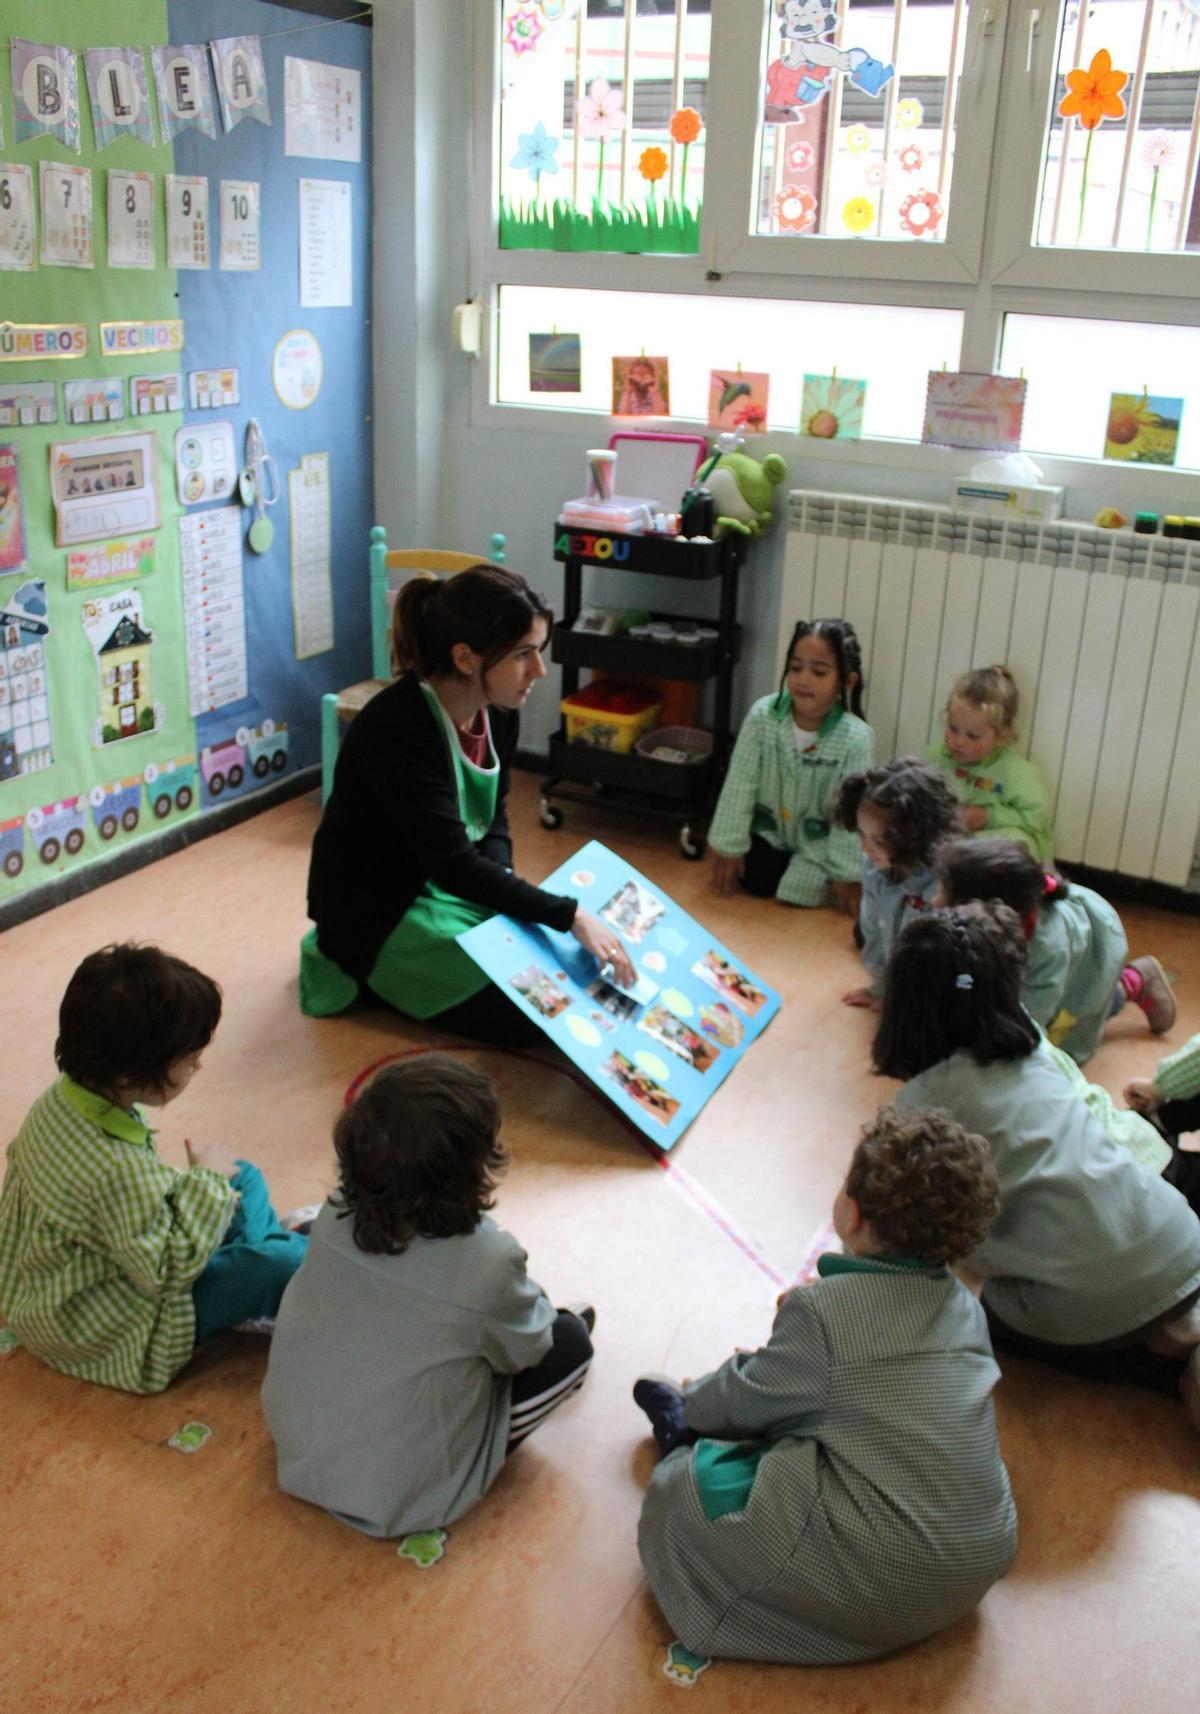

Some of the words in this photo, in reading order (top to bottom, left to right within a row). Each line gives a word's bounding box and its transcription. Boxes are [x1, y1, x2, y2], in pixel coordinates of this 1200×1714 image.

[0, 179, 12, 210] 6
[62, 179, 73, 208] 7
[126, 184, 136, 214] 8
[182, 189, 192, 217] 9
[231, 194, 249, 221] 10
[104, 327, 180, 348] VECINOS
[554, 533, 631, 561] AEIOU
[87, 549, 137, 579] ABRIL
[109, 599, 133, 613] CASA
